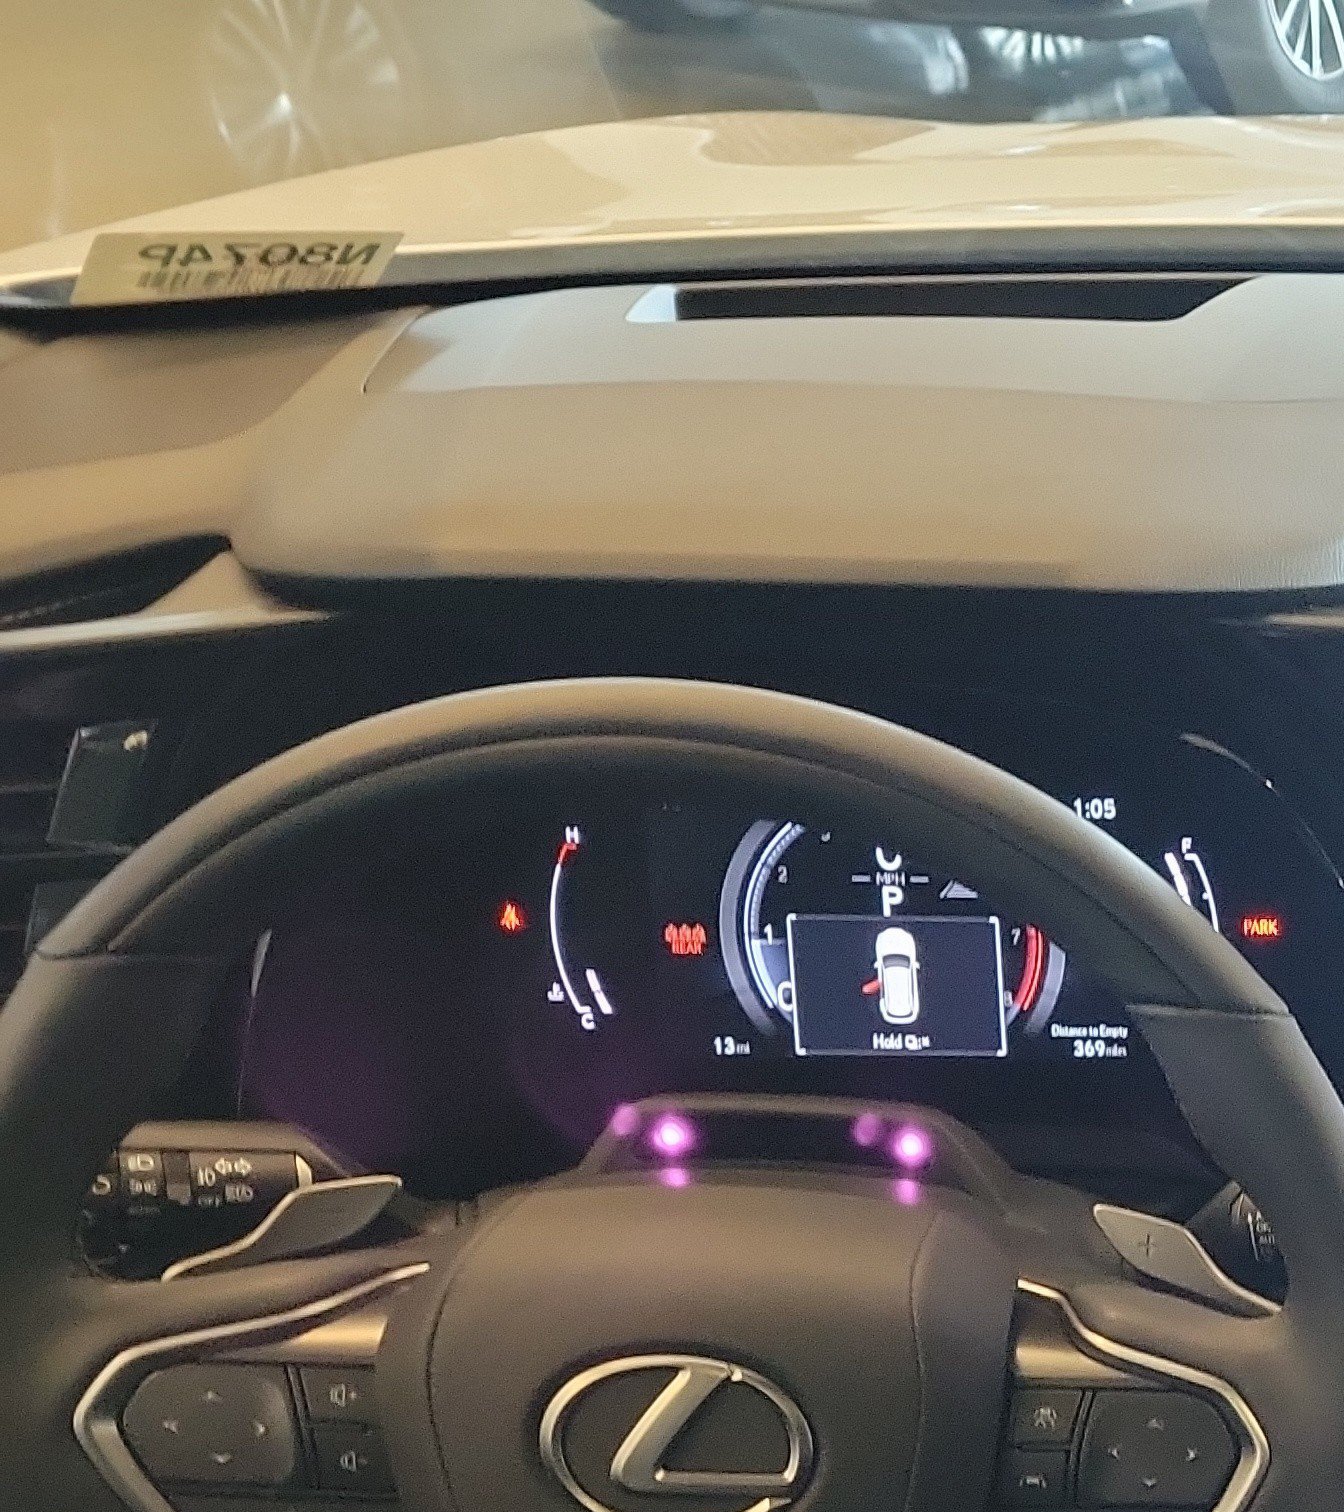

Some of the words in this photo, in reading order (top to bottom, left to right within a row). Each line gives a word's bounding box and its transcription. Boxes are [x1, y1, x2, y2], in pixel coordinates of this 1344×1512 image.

[1074, 797, 1117, 821] 1:05
[875, 871, 906, 886] MPH
[881, 885, 904, 918] P
[1243, 916, 1279, 937] PARK
[1050, 1023, 1088, 1038] Distance
[1088, 1025, 1099, 1038] to
[1099, 1023, 1129, 1040] Empty
